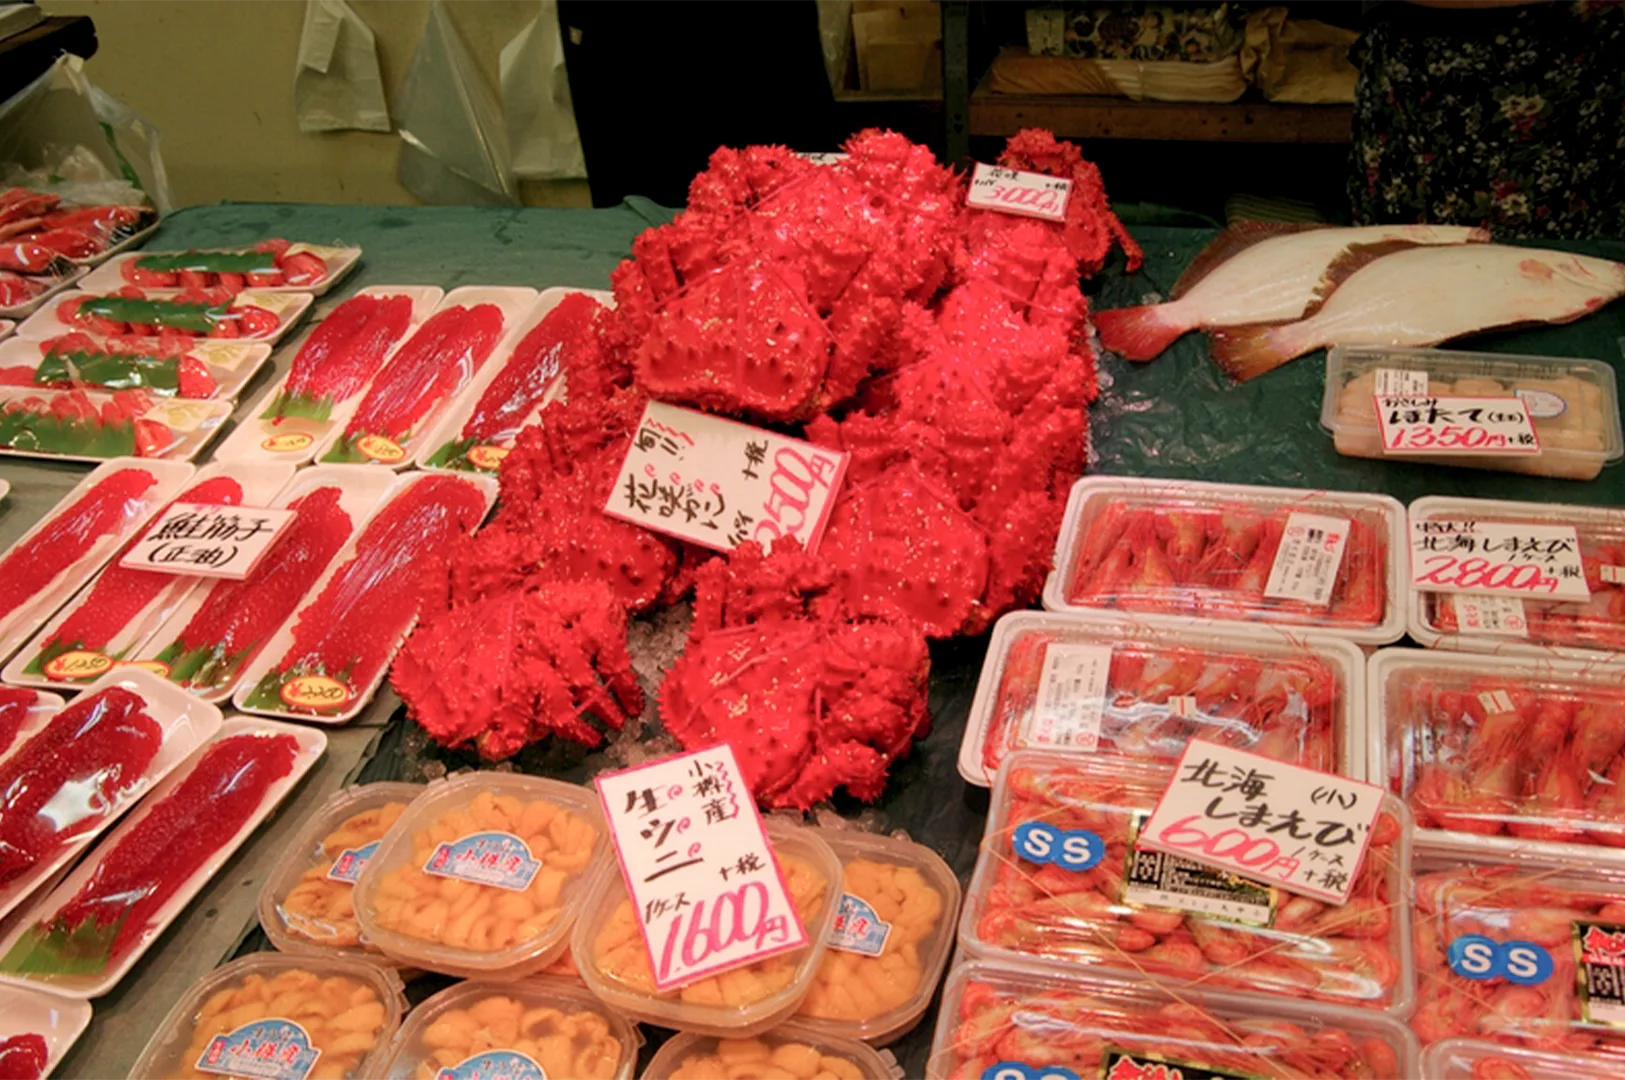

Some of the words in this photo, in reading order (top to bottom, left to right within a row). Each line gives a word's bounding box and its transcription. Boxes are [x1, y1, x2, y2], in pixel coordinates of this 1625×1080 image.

[1414, 554, 1561, 593] 2800円
[1180, 757, 1276, 802] 北海
[1204, 796, 1371, 848] しまえび
[1158, 814, 1301, 881] 600円
